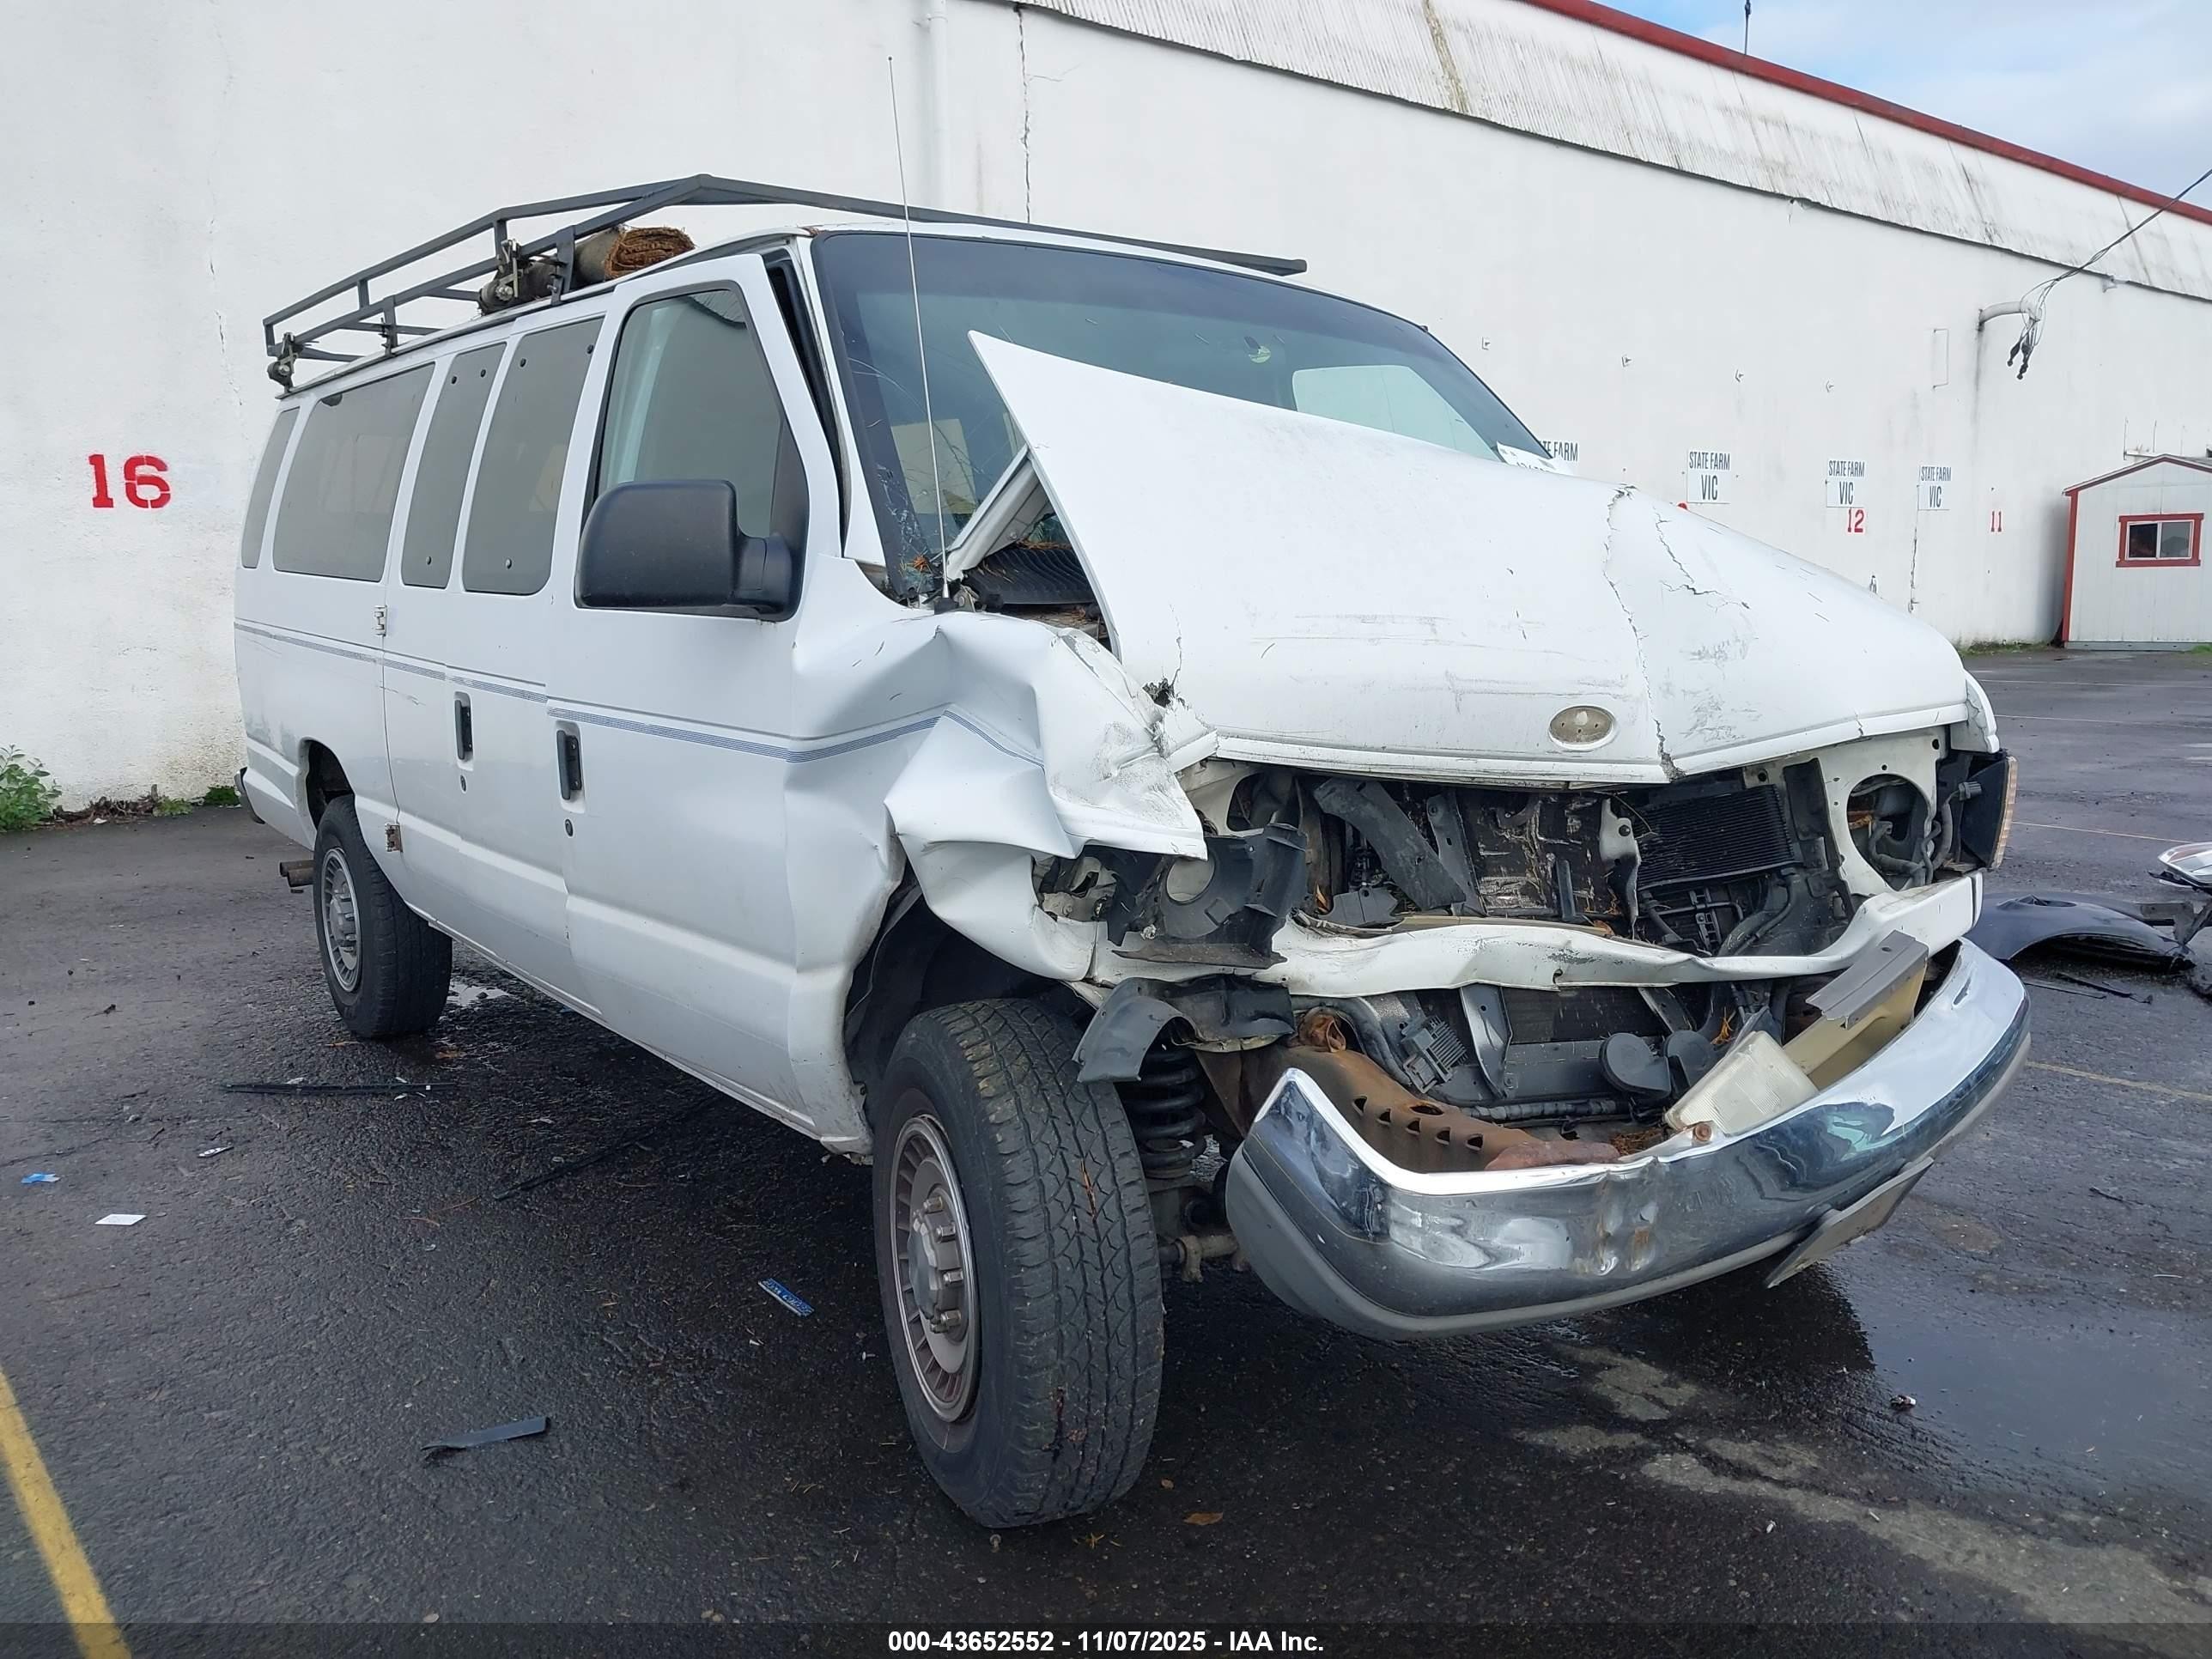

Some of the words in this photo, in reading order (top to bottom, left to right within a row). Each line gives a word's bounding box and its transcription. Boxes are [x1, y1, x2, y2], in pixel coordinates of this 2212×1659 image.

[1553, 441, 1578, 462] FARM
[1689, 451, 1709, 470] STATE
[1710, 452, 1730, 471] FARM
[1828, 460, 1846, 477] STATE
[1847, 461, 1865, 477] FARM
[1921, 466, 1936, 482] STATE
[1936, 466, 1952, 482] FARM
[88, 453, 172, 509] 16
[1701, 474, 1718, 501] VIC
[1839, 481, 1854, 505] VIC
[1929, 485, 1942, 507] VIC
[1847, 508, 1864, 533] 12
[1990, 510, 2002, 532] 11
